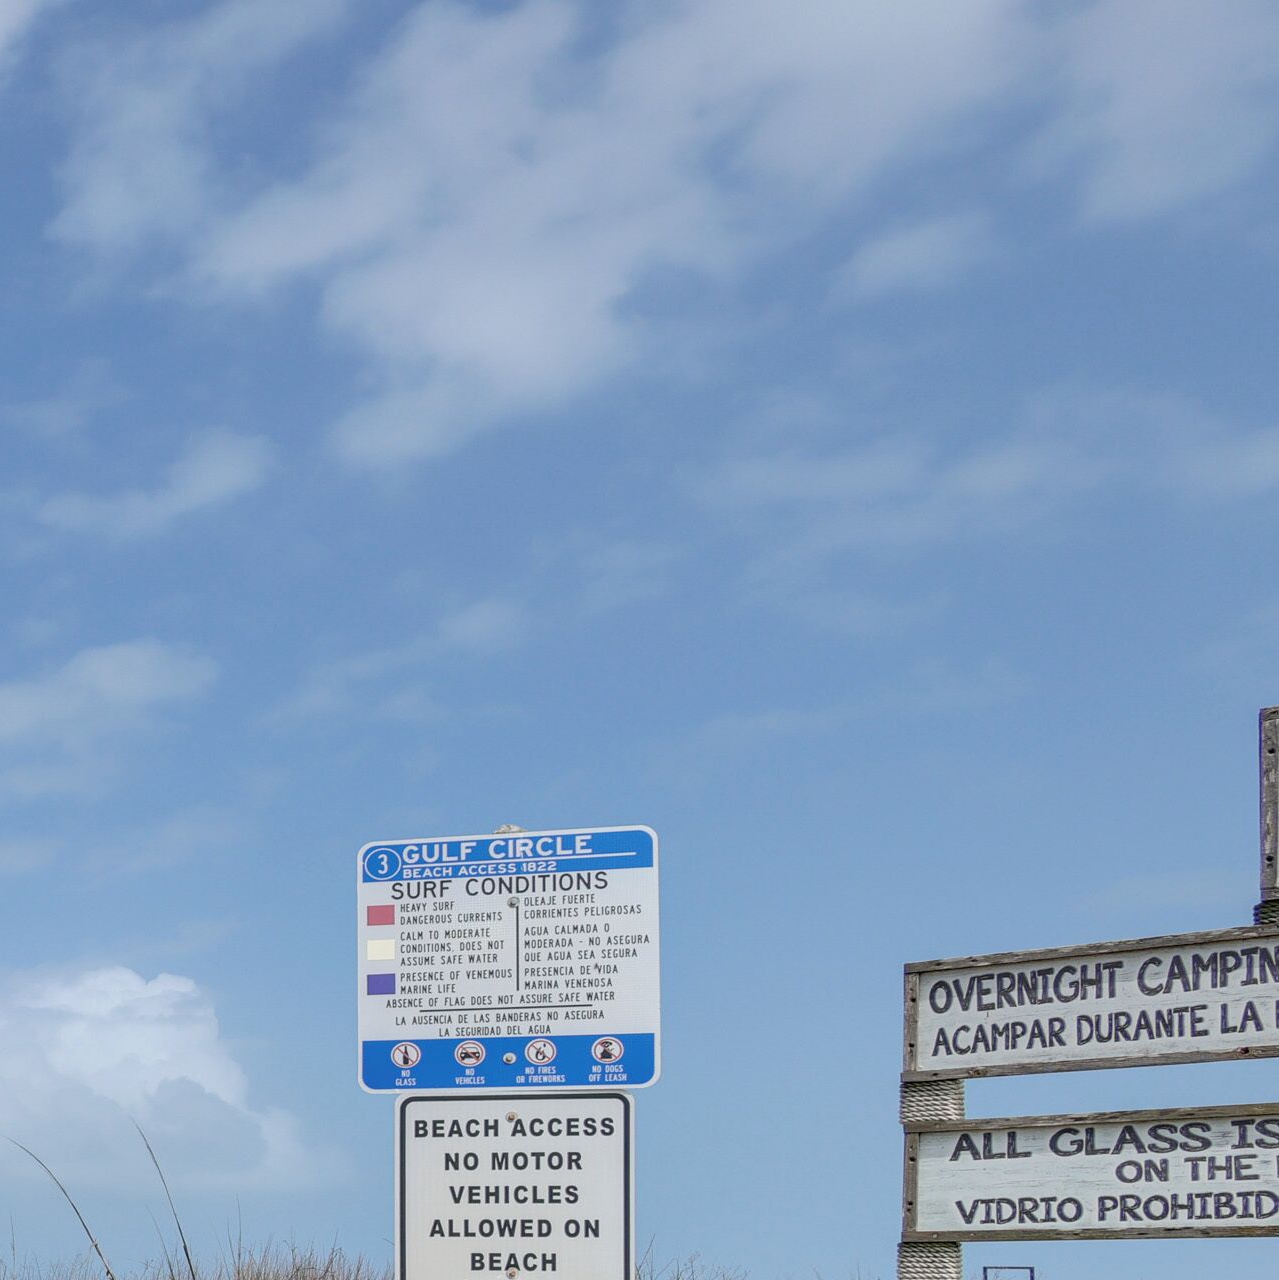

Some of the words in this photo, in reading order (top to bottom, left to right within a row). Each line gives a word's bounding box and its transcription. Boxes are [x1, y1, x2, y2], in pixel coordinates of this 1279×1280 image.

[403, 842, 476, 863] GULF
[489, 835, 592, 859] CIRCLE
[378, 854, 388, 874] 3
[403, 867, 452, 878] BEACH
[459, 864, 516, 875] ACCESS
[523, 861, 557, 872] 1822
[392, 880, 452, 900] SURF
[465, 871, 608, 896] CONDITIONS
[401, 902, 426, 912] HEAVY
[433, 901, 455, 911] SURF
[524, 896, 556, 906] OLEAJE
[563, 894, 595, 904] FUERTE
[401, 914, 452, 925] DANGEROUS
[458, 912, 502, 923] CURRENTS
[524, 908, 578, 919] CORRIENTES
[585, 905, 641, 916] PELIGROSAS
[401, 931, 423, 940] CALM
[429, 930, 439, 939] TO
[445, 928, 490, 938] MODERATE
[525, 927, 549, 936] AGUA
[555, 924, 598, 934] CALMADA
[460, 941, 481, 951] DOES
[488, 940, 504, 950] NOT
[525, 938, 573, 948] MODERADA
[589, 937, 600, 946] NO
[607, 934, 649, 945] ASEGURA
[401, 956, 435, 966] ASSUME
[441, 955, 463, 964] SAFE
[468, 954, 498, 963] WATER
[525, 952, 541, 962] QUE
[547, 951, 572, 961] AGUA
[578, 950, 595, 959] SEA
[602, 948, 637, 958] SEGURA
[401, 972, 444, 981] PRESENCE
[450, 971, 460, 980] OF
[466, 969, 512, 979] VENEMOUS
[525, 966, 574, 976] PRESENCIA
[581, 966, 591, 974] DE
[401, 985, 432, 994] MARINE
[438, 984, 456, 993] LIFE
[525, 980, 559, 989] MARINA
[565, 978, 612, 988] VENENOSA
[929, 961, 1123, 1014] OVERNIGHT
[386, 998, 423, 1008] ABSENCE
[429, 998, 438, 1006] OF
[445, 997, 465, 1006] FLAG
[471, 996, 492, 1005] DOES
[498, 995, 513, 1004] NOT
[520, 994, 552, 1003] ASSURE
[559, 993, 580, 1002] SAFE
[587, 992, 614, 1001] WATER
[396, 1017, 406, 1025] LA
[412, 1015, 452, 1025] AUSENCIA
[458, 1015, 468, 1023] DE
[474, 1014, 490, 1023] LAS
[496, 1012, 541, 1022] BANDERAS
[548, 1011, 558, 1020] NO
[565, 1010, 604, 1020] ASEGURA
[440, 1028, 449, 1037] LA
[456, 1026, 501, 1036] SEGURIDAD
[507, 1026, 521, 1035] DEL
[529, 1025, 551, 1034] AGUA
[932, 1017, 1066, 1056] ACAMPAR
[1076, 1004, 1209, 1046] DURANTE
[1221, 1000, 1264, 1034] LA
[589, 1074, 601, 1082] OFF
[414, 1119, 499, 1138] BEACH
[511, 1118, 614, 1137] ACCESS
[949, 1131, 1032, 1162] ALL
[1049, 1122, 1212, 1157] GLASS
[1230, 1118, 1279, 1150] IS
[445, 1153, 479, 1171] NO
[491, 1152, 582, 1170] MOTOR
[1115, 1159, 1169, 1183] ON
[1184, 1155, 1259, 1181] THE
[450, 1186, 579, 1204] VEHICLES
[955, 1196, 1083, 1225] VIDRIO
[430, 1220, 552, 1237] ALLOWED
[564, 1220, 600, 1238] ON
[471, 1253, 557, 1271] BEACH
